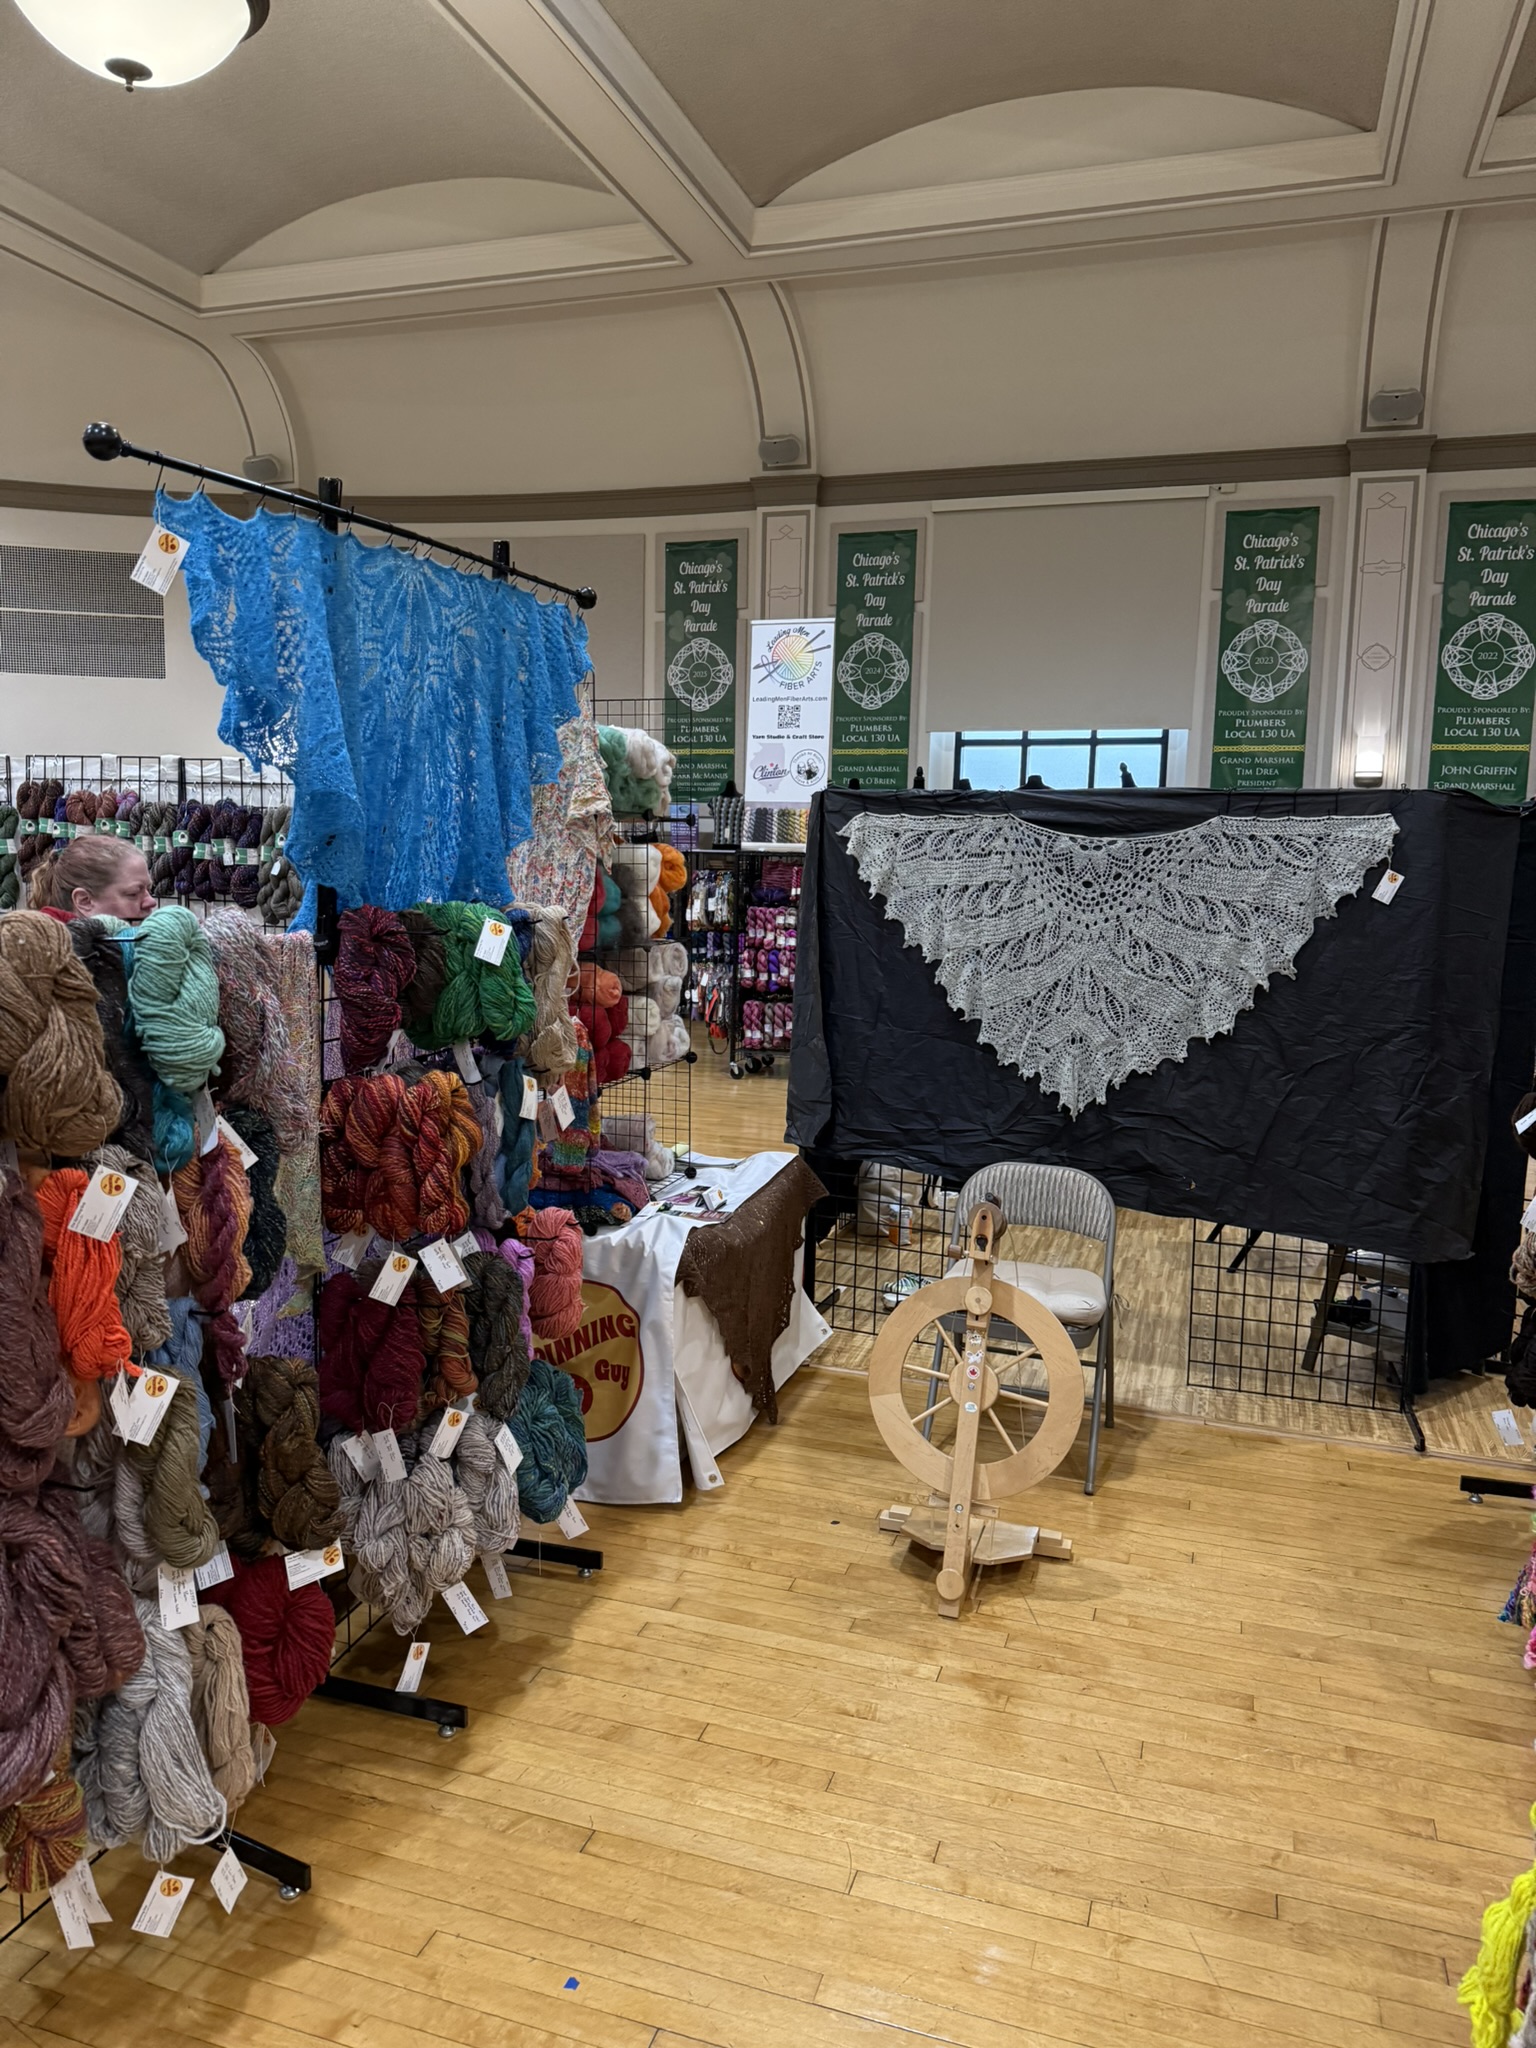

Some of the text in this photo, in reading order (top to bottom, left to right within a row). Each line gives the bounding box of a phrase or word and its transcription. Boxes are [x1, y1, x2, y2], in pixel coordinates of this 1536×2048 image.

[1467, 521, 1529, 543] Chicago's
[1242, 532, 1299, 552] Chicago's
[852, 551, 900, 570] Chicago's
[1457, 544, 1535, 562] St. Patrick's
[679, 560, 723, 578] Chicago's
[1234, 554, 1305, 571] St. Patrick's
[845, 571, 906, 588] St. Patrick's
[1256, 576, 1282, 595] Day
[1480, 568, 1509, 588] Day
[673, 579, 728, 595] St. Patrick's
[864, 593, 886, 610] Day
[1245, 598, 1290, 614] Parade
[1469, 591, 1517, 607] Parade
[690, 599, 711, 617] Day
[683, 619, 718, 633] Parade
[856, 613, 893, 627] Parade
[766, 626, 811, 653] Leading Men
[1254, 657, 1274, 665] 2023
[1477, 652, 1498, 660] 2022
[779, 660, 823, 691] FIBER ARTS
[864, 667, 881, 675] 2024
[850, 724, 892, 732] PLUMBERS
[1235, 718, 1286, 727] PLUMBERS
[1455, 716, 1511, 725] PLUMBERS
[700, 734, 714, 743] 130
[715, 734, 727, 743] UA
[842, 734, 901, 743] LOCAL 130 UA
[1225, 729, 1296, 738] LOCAL 130 UA
[1444, 727, 1520, 737] LOCAL 130 UA
[753, 763, 790, 781] Clinton
[1440, 765, 1517, 777] JOHN GRIFFIN
